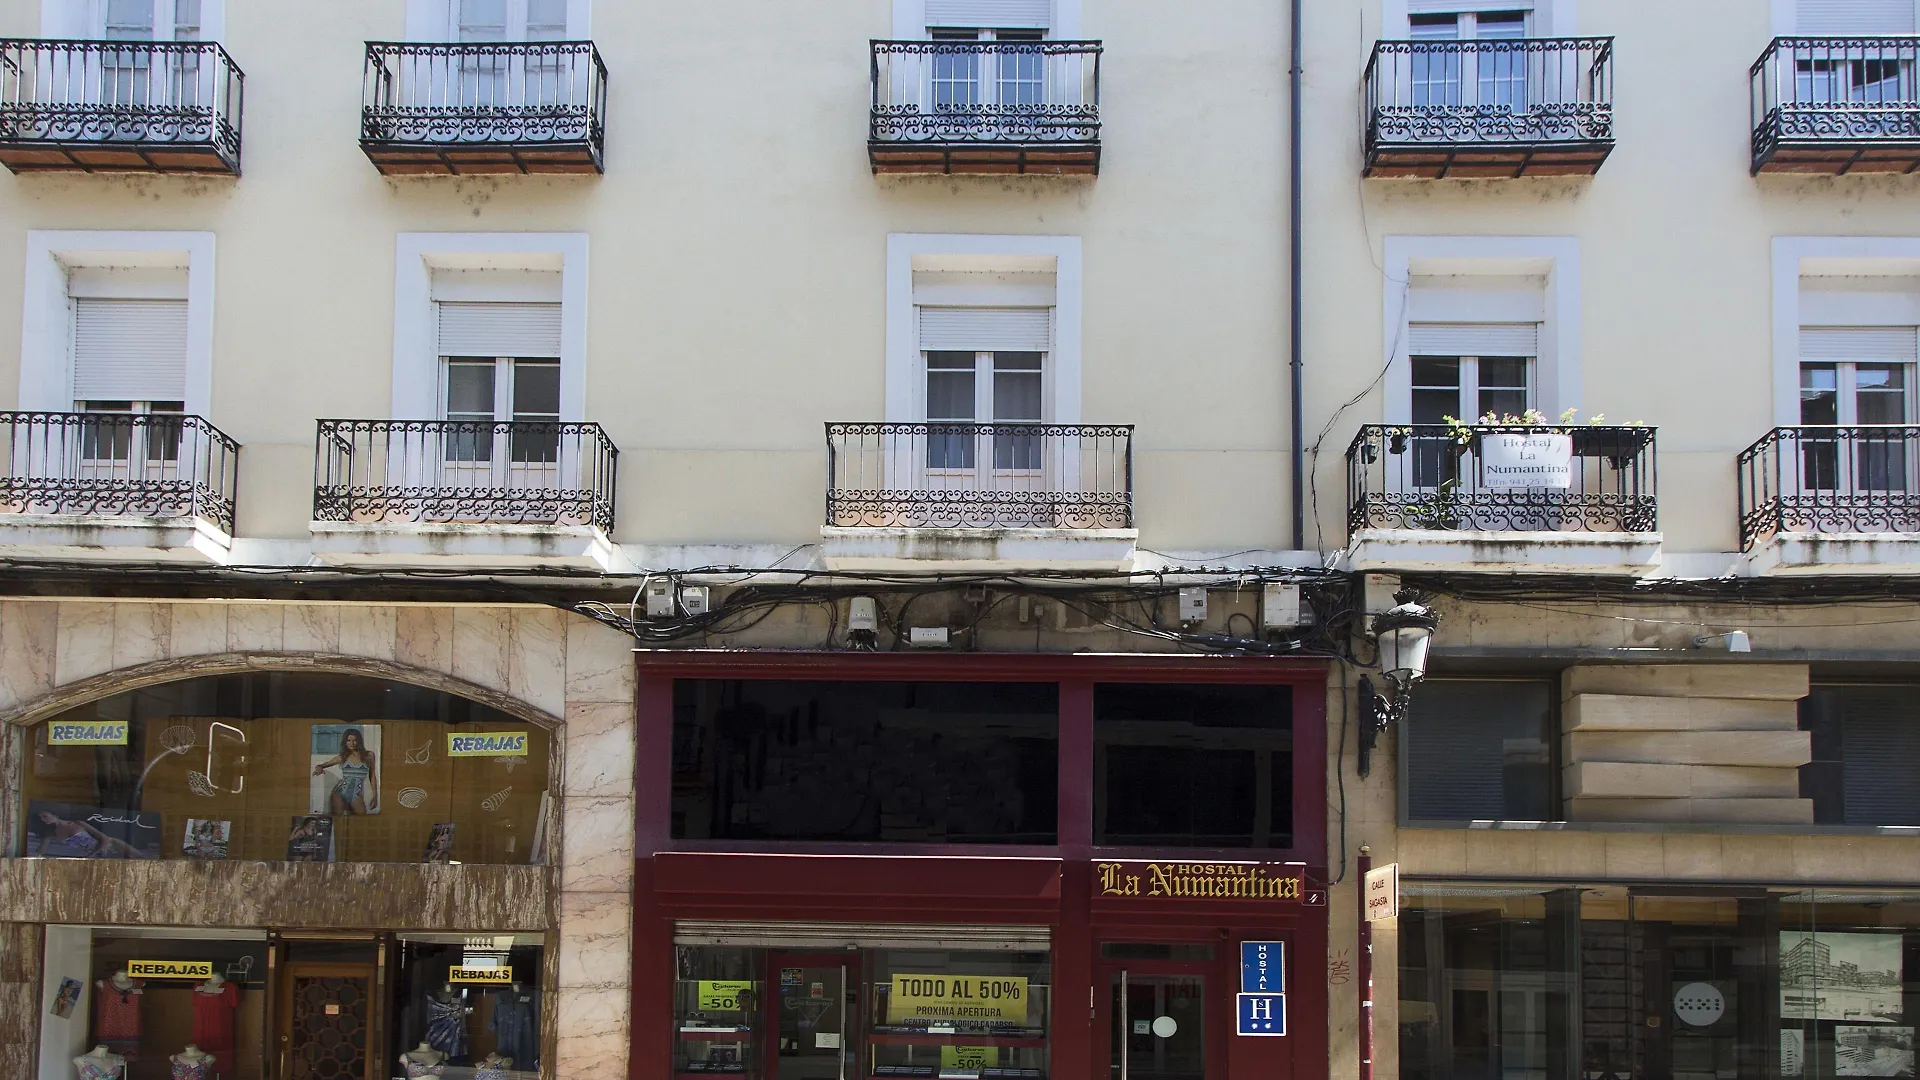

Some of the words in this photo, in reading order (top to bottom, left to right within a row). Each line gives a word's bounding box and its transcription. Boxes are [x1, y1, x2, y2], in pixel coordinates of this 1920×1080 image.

[1503, 438, 1551, 447] Hostal
[1520, 451, 1536, 460] La
[1487, 464, 1568, 474] Numantina
[52, 724, 126, 741] REBAJAS
[452, 735, 525, 752] REBAJAS
[1178, 864, 1247, 875] HOSTAL
[1098, 863, 1140, 897] La
[1146, 862, 1300, 898] Numantina
[1371, 879, 1385, 890] CALLE
[1368, 896, 1388, 908] SAGASTA
[131, 963, 210, 976] REBAJAS
[1258, 945, 1267, 990] HOSTAL
[451, 969, 510, 980] REBAJAS
[899, 979, 945, 997] TODO
[951, 980, 973, 999] AL
[979, 981, 1020, 1000] 50%
[916, 1006, 955, 1016] PROXIMA
[958, 1007, 1001, 1017] APERTURA
[904, 1018, 931, 1026] CENTRO
[952, 1059, 987, 1069] -50%
